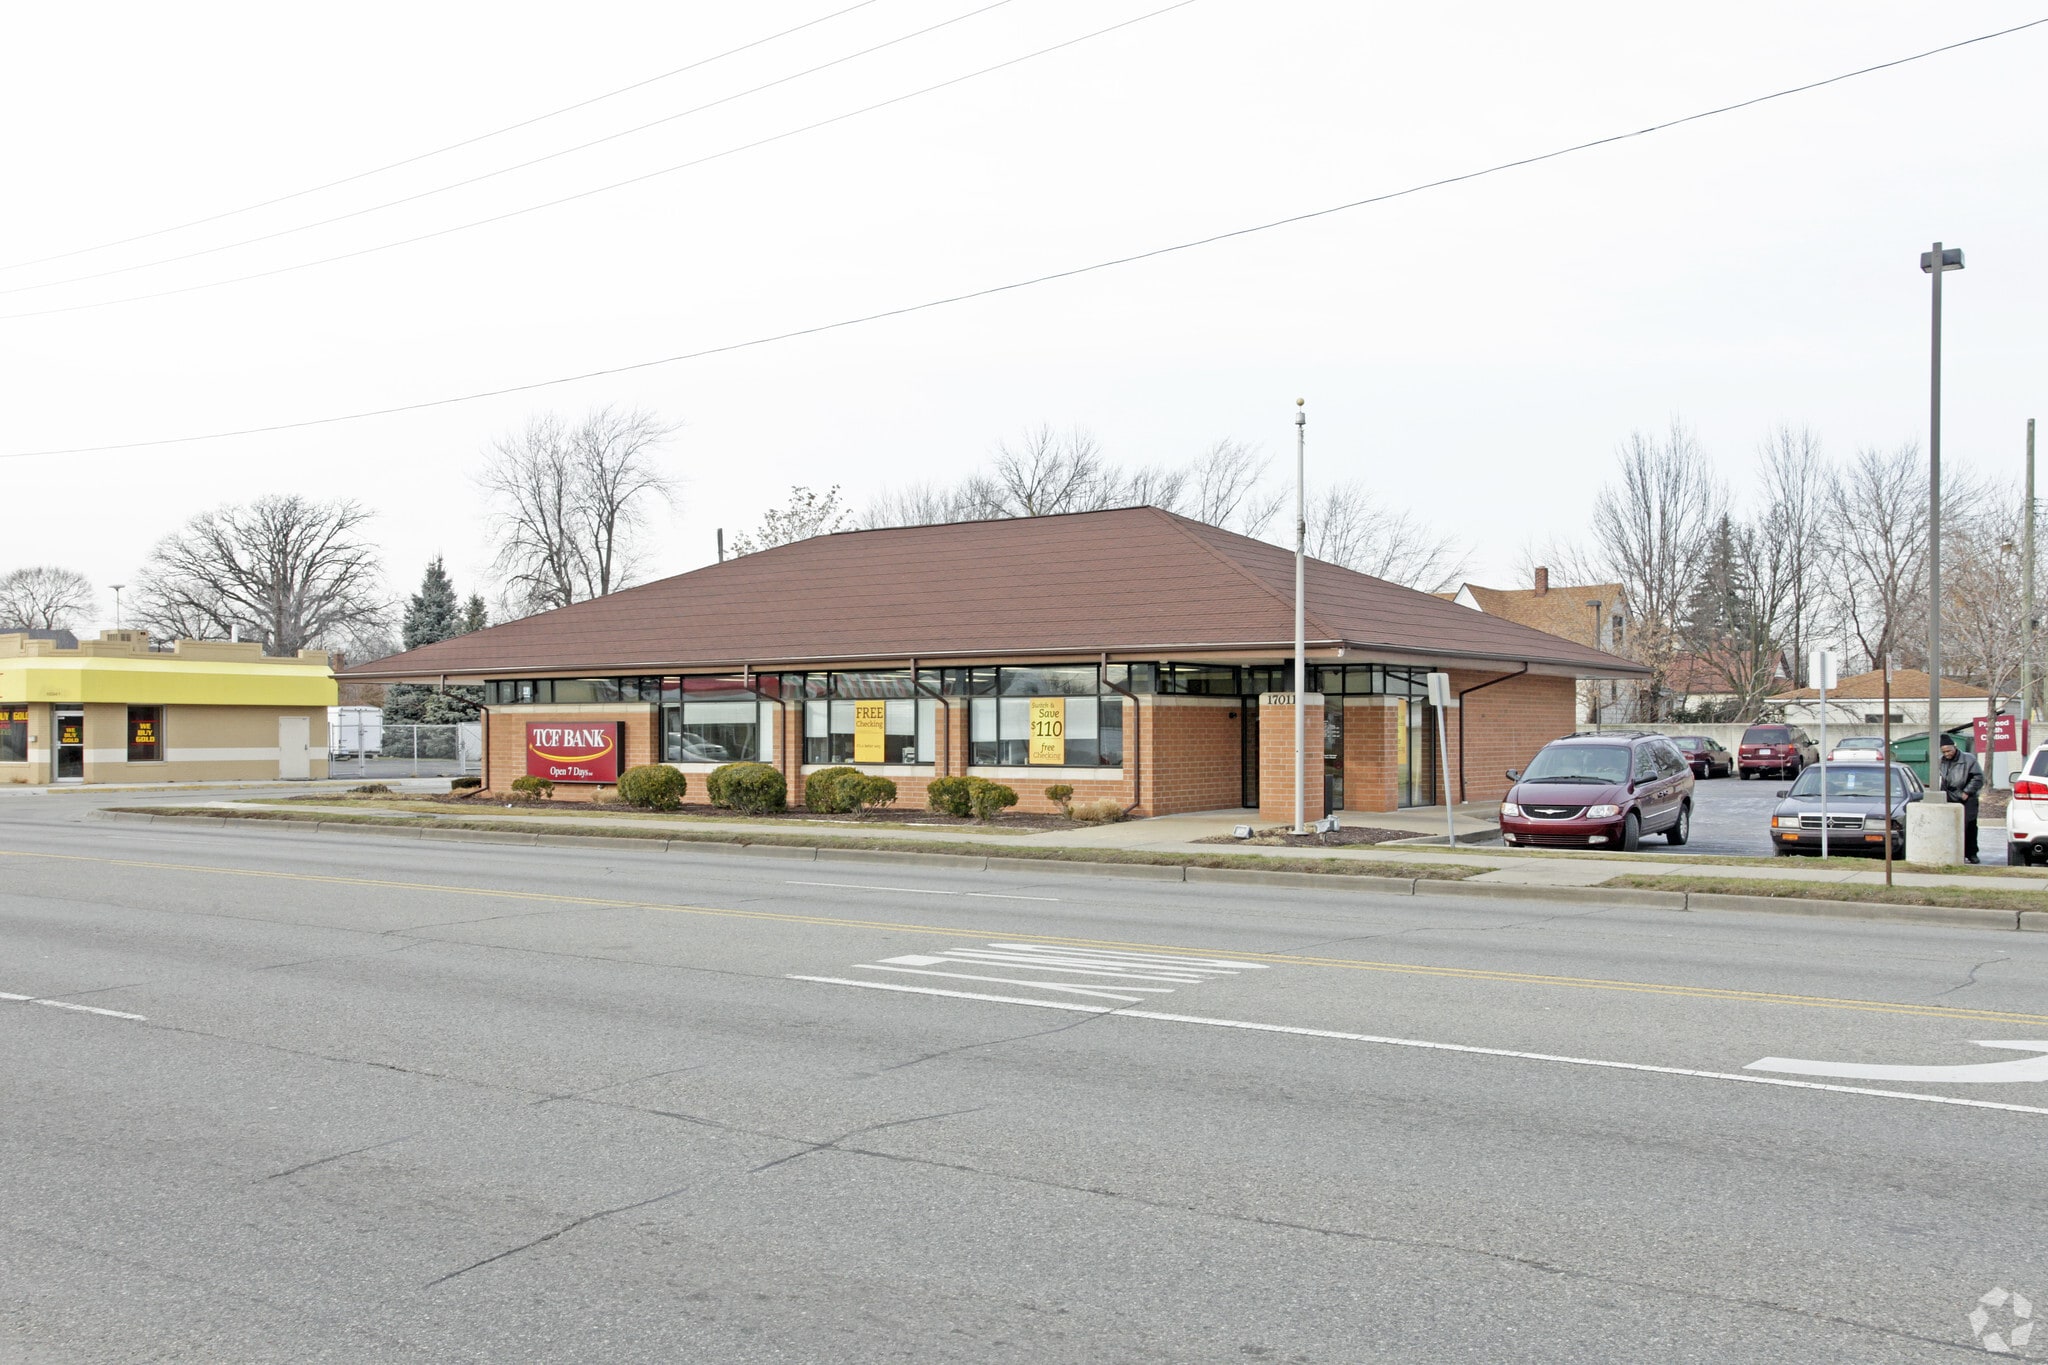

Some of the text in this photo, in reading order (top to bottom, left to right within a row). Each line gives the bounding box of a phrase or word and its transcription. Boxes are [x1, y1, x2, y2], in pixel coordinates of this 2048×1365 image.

[1268, 695, 1296, 705] 17011
[0, 711, 10, 720] UY
[856, 707, 884, 719] FREE
[1039, 708, 1060, 719] Save
[856, 720, 884, 730] Checking
[1030, 720, 1063, 737] $110
[1978, 720, 2010, 728] Preed
[533, 729, 605, 748] TCF BANK
[1041, 742, 1055, 754] free
[1032, 752, 1062, 761] Checking
[549, 766, 566, 777] Open
[568, 766, 572, 776] 7
